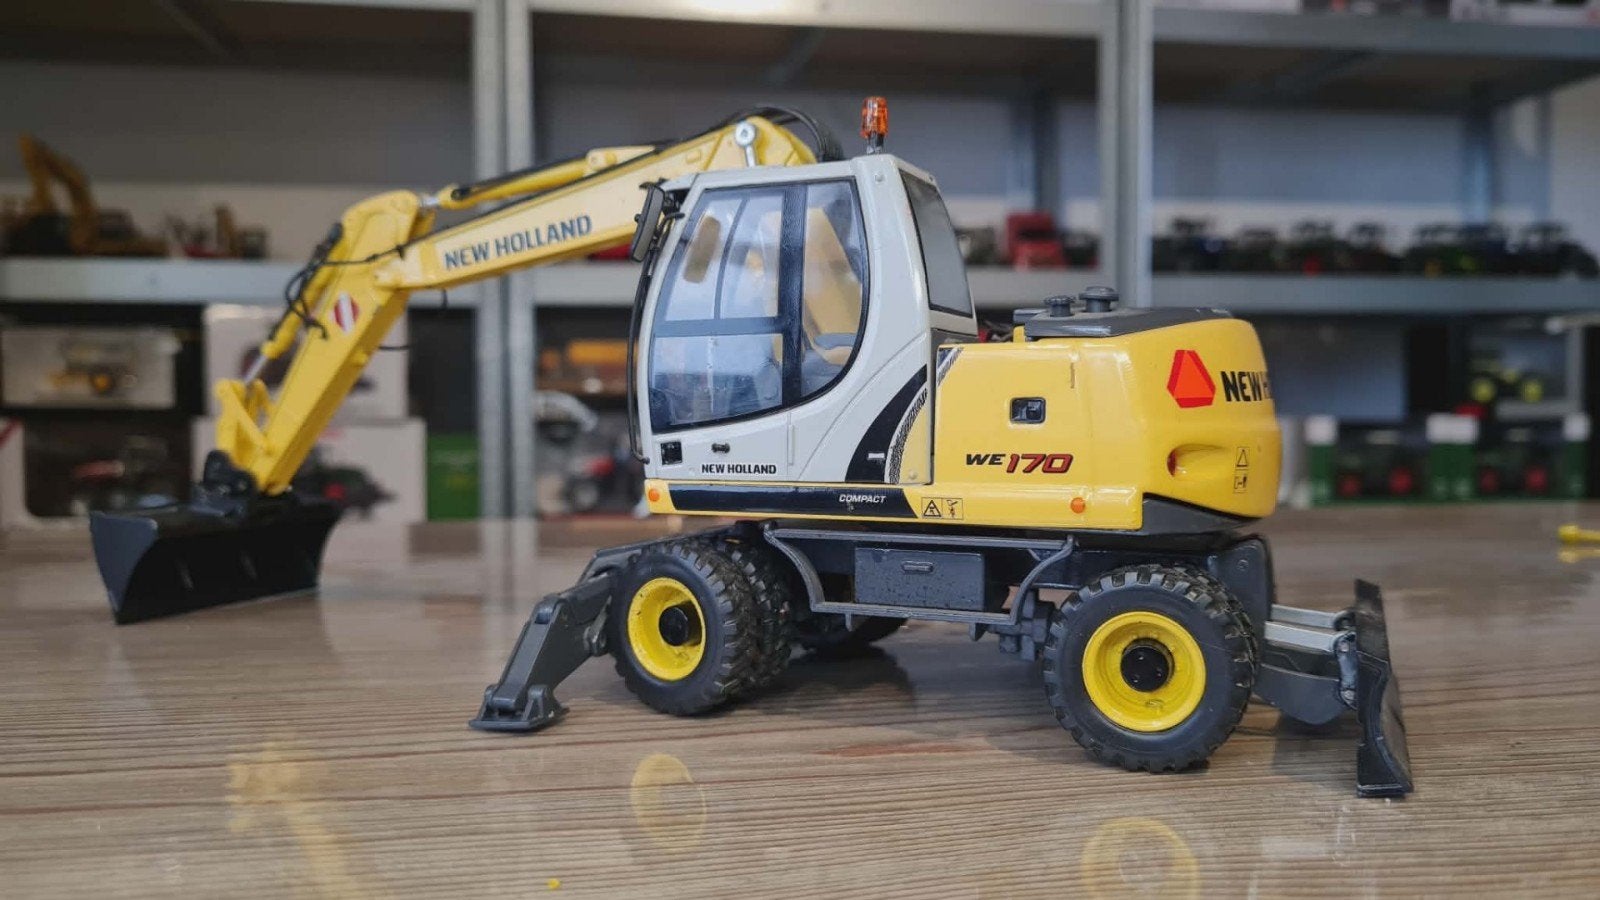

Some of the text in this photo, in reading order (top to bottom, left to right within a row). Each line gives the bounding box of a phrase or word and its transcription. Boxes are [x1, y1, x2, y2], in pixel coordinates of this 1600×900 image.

[444, 215, 592, 270] NEW HOLLAND
[1220, 371, 1262, 401] NEW
[701, 464, 776, 474] NEW HOLLAND
[839, 493, 887, 503] COMPACT
